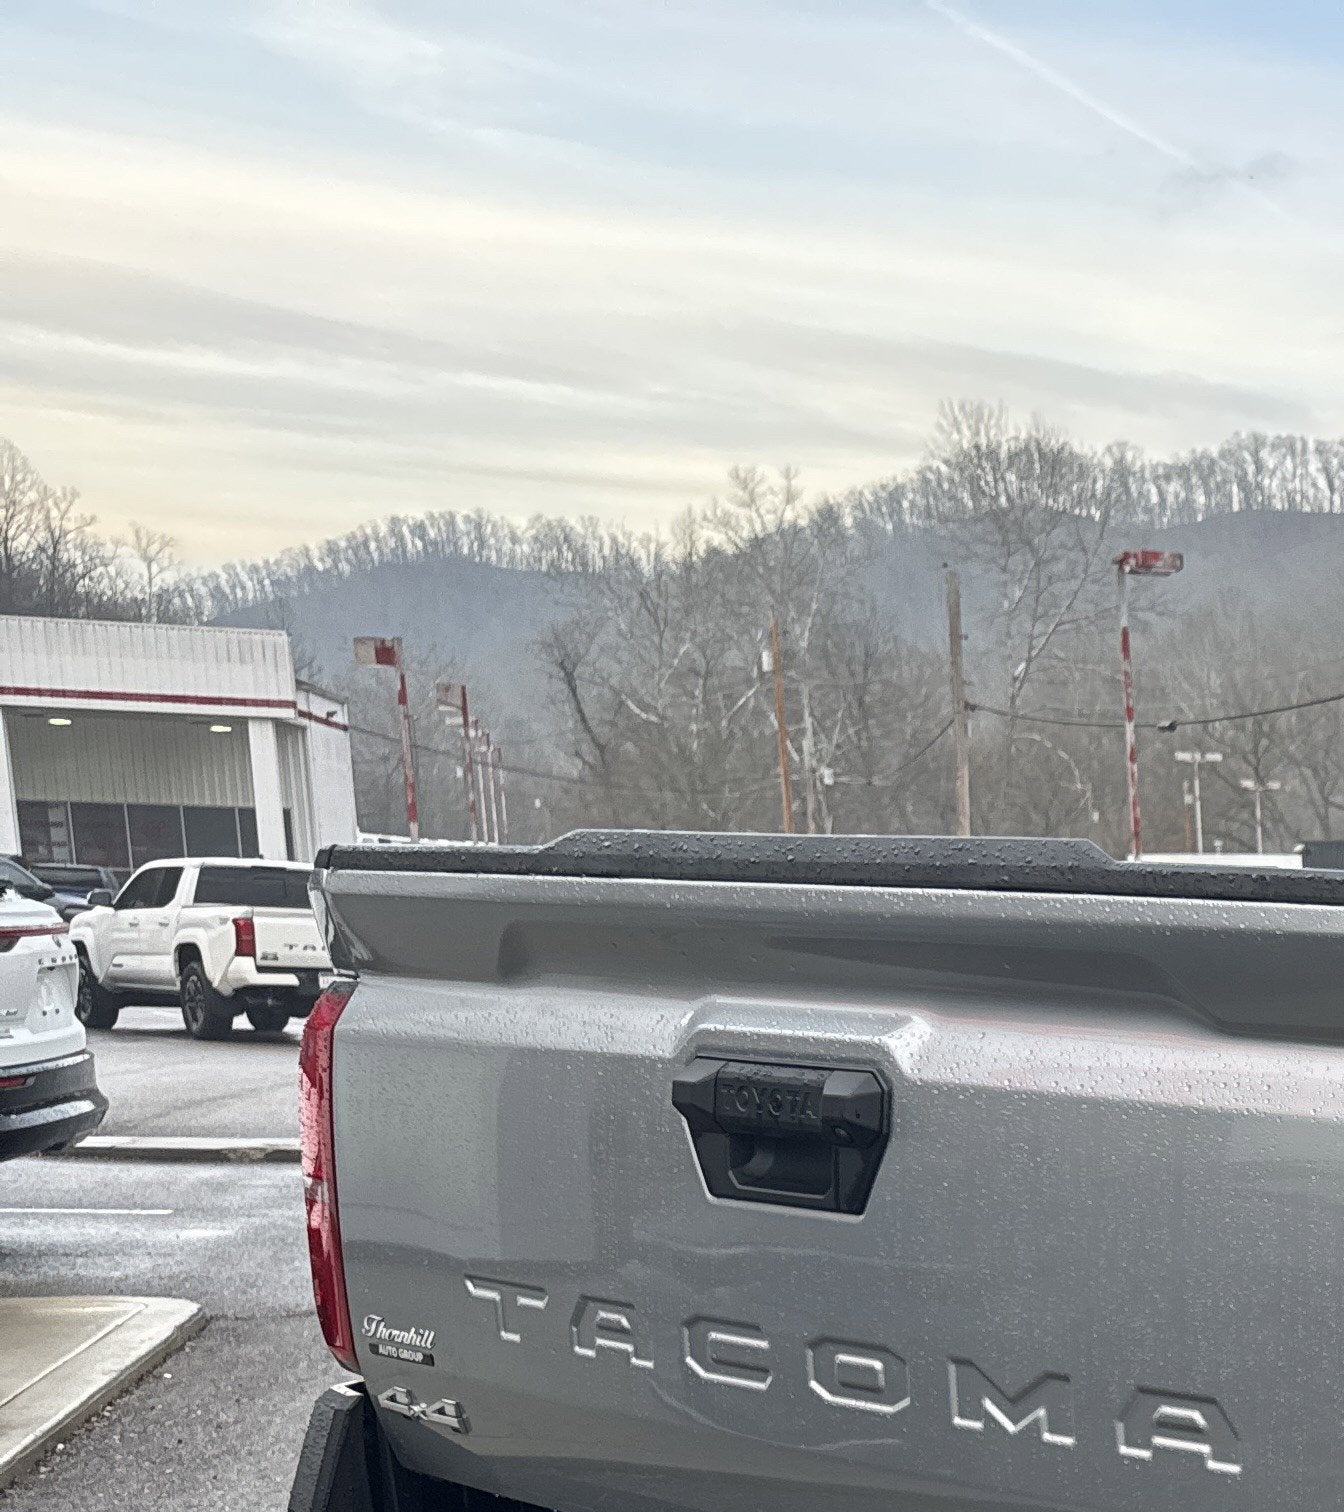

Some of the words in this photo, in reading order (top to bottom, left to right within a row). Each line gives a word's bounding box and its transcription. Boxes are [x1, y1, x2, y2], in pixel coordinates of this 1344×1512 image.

[720, 1083, 818, 1119] TOYOTA
[362, 1314, 435, 1349] Thornhill
[378, 1344, 398, 1358] AUTO
[399, 1348, 424, 1362] GROUP
[463, 1273, 1243, 1474] TACOMA
